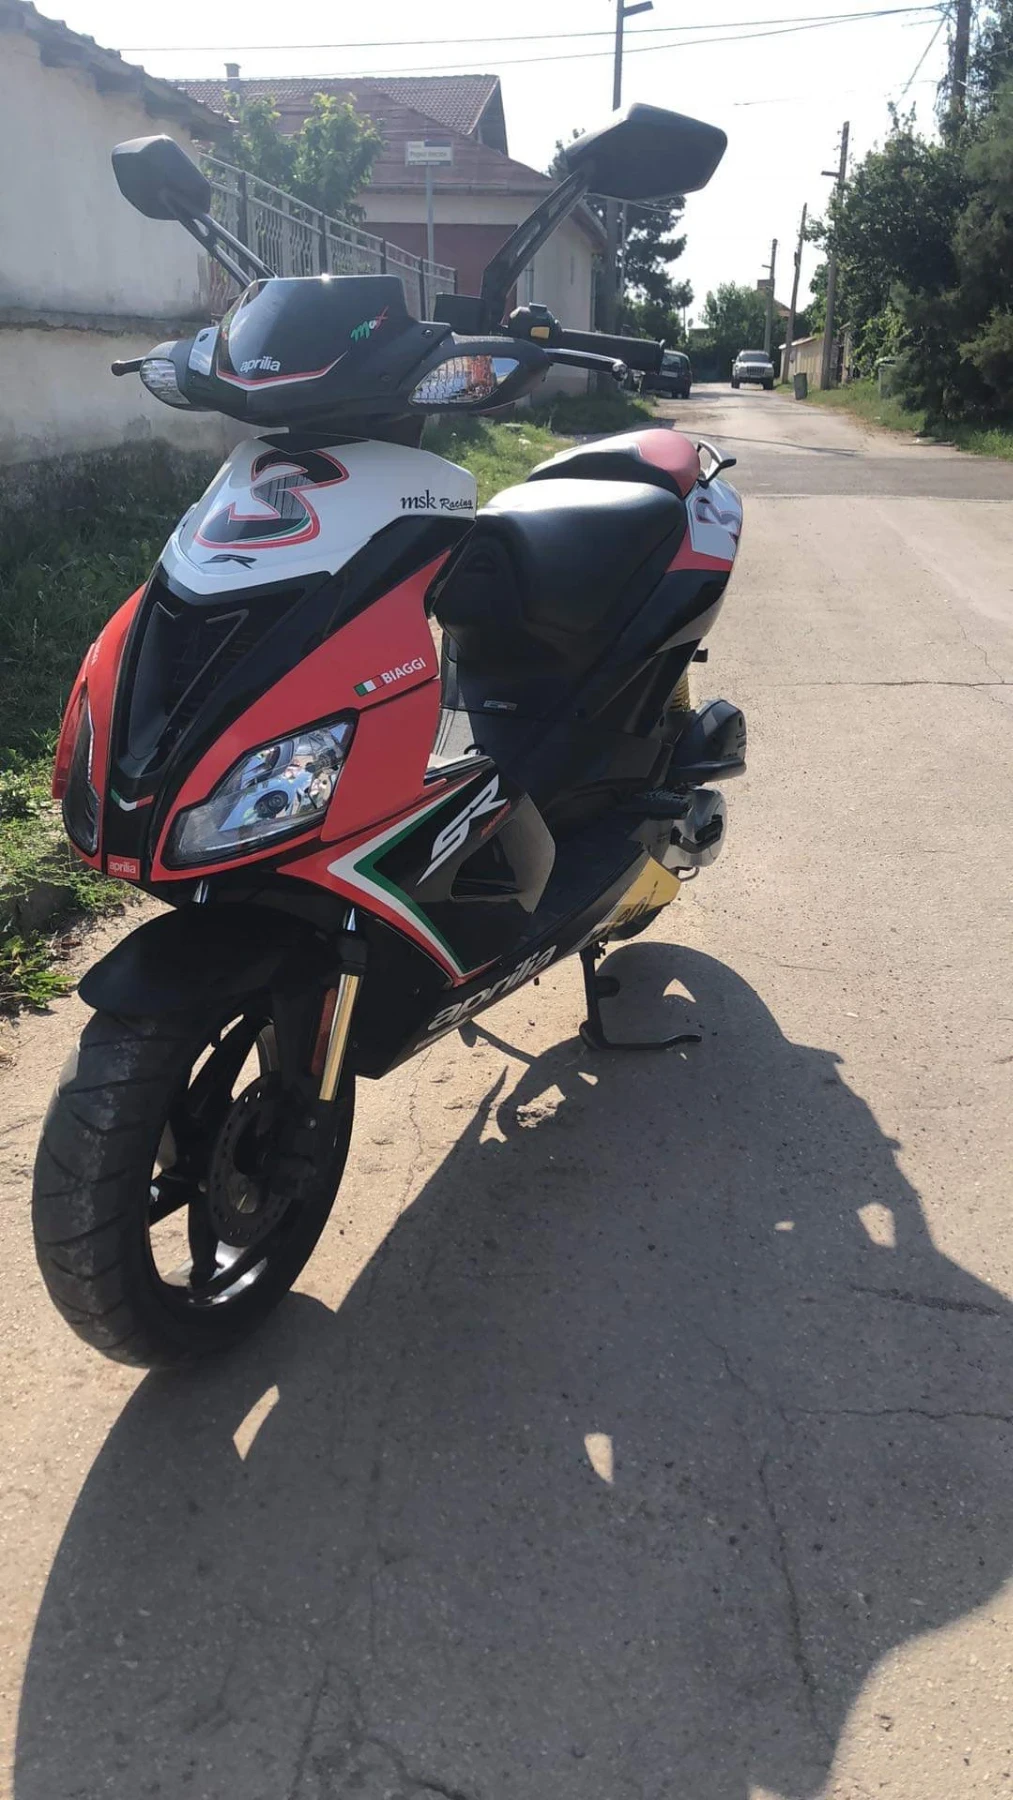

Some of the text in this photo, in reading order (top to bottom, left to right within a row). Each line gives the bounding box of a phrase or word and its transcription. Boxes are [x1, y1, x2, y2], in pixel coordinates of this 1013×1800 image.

[240, 355, 281, 373] aprilia
[400, 489, 474, 511] msk Racing
[381, 657, 427, 684] BIAGGI
[109, 860, 137, 874] aprilia
[427, 945, 557, 1031] aprilia
